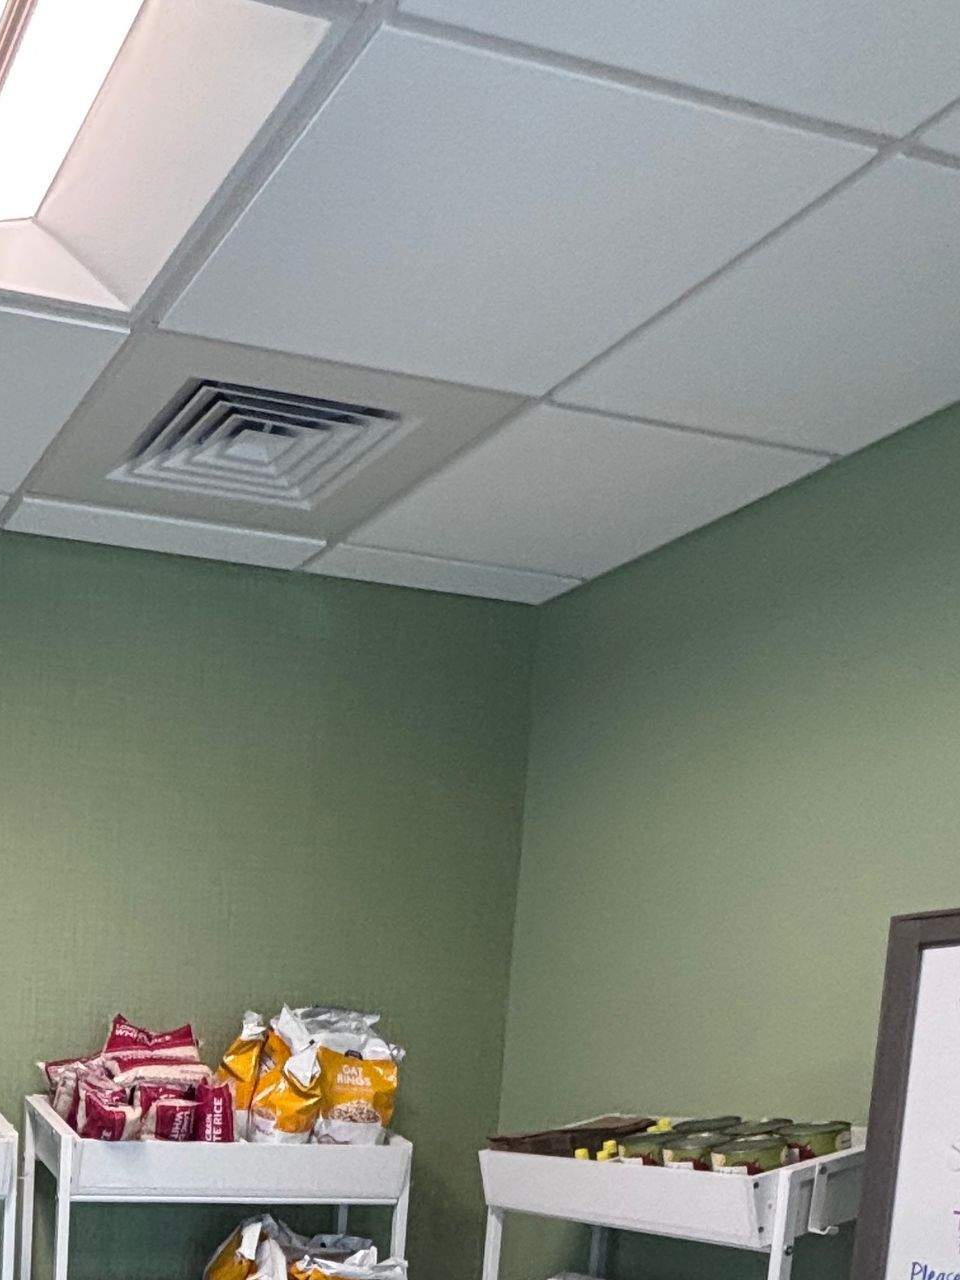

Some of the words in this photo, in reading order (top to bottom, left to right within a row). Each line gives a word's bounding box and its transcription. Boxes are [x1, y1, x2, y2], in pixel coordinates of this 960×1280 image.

[342, 1064, 364, 1077] OAT
[336, 1073, 372, 1087] RINGS
[213, 1097, 223, 1125] RICE
